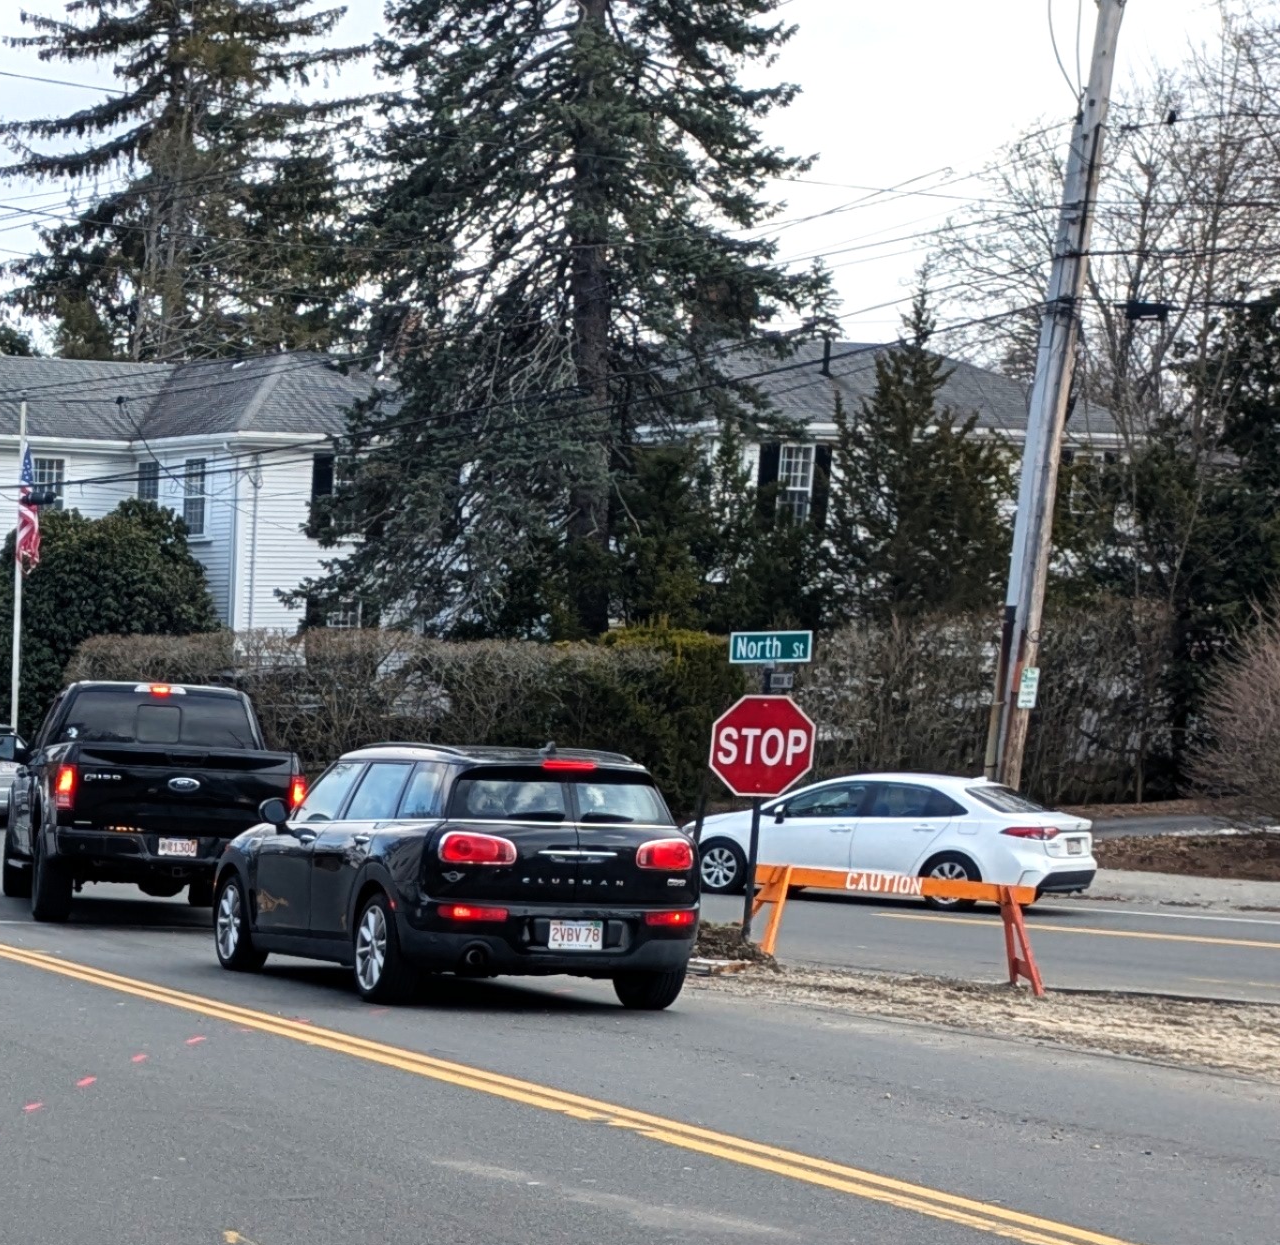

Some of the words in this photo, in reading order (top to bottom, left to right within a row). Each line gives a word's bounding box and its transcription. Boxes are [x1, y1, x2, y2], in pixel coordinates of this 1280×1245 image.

[736, 636, 782, 658] North
[791, 641, 805, 657] St
[717, 726, 808, 766] STOP
[522, 877, 624, 887] CLUBMAN
[845, 872, 923, 895] CAUTION
[551, 927, 582, 942] 2VBV
[584, 927, 600, 943] 78
